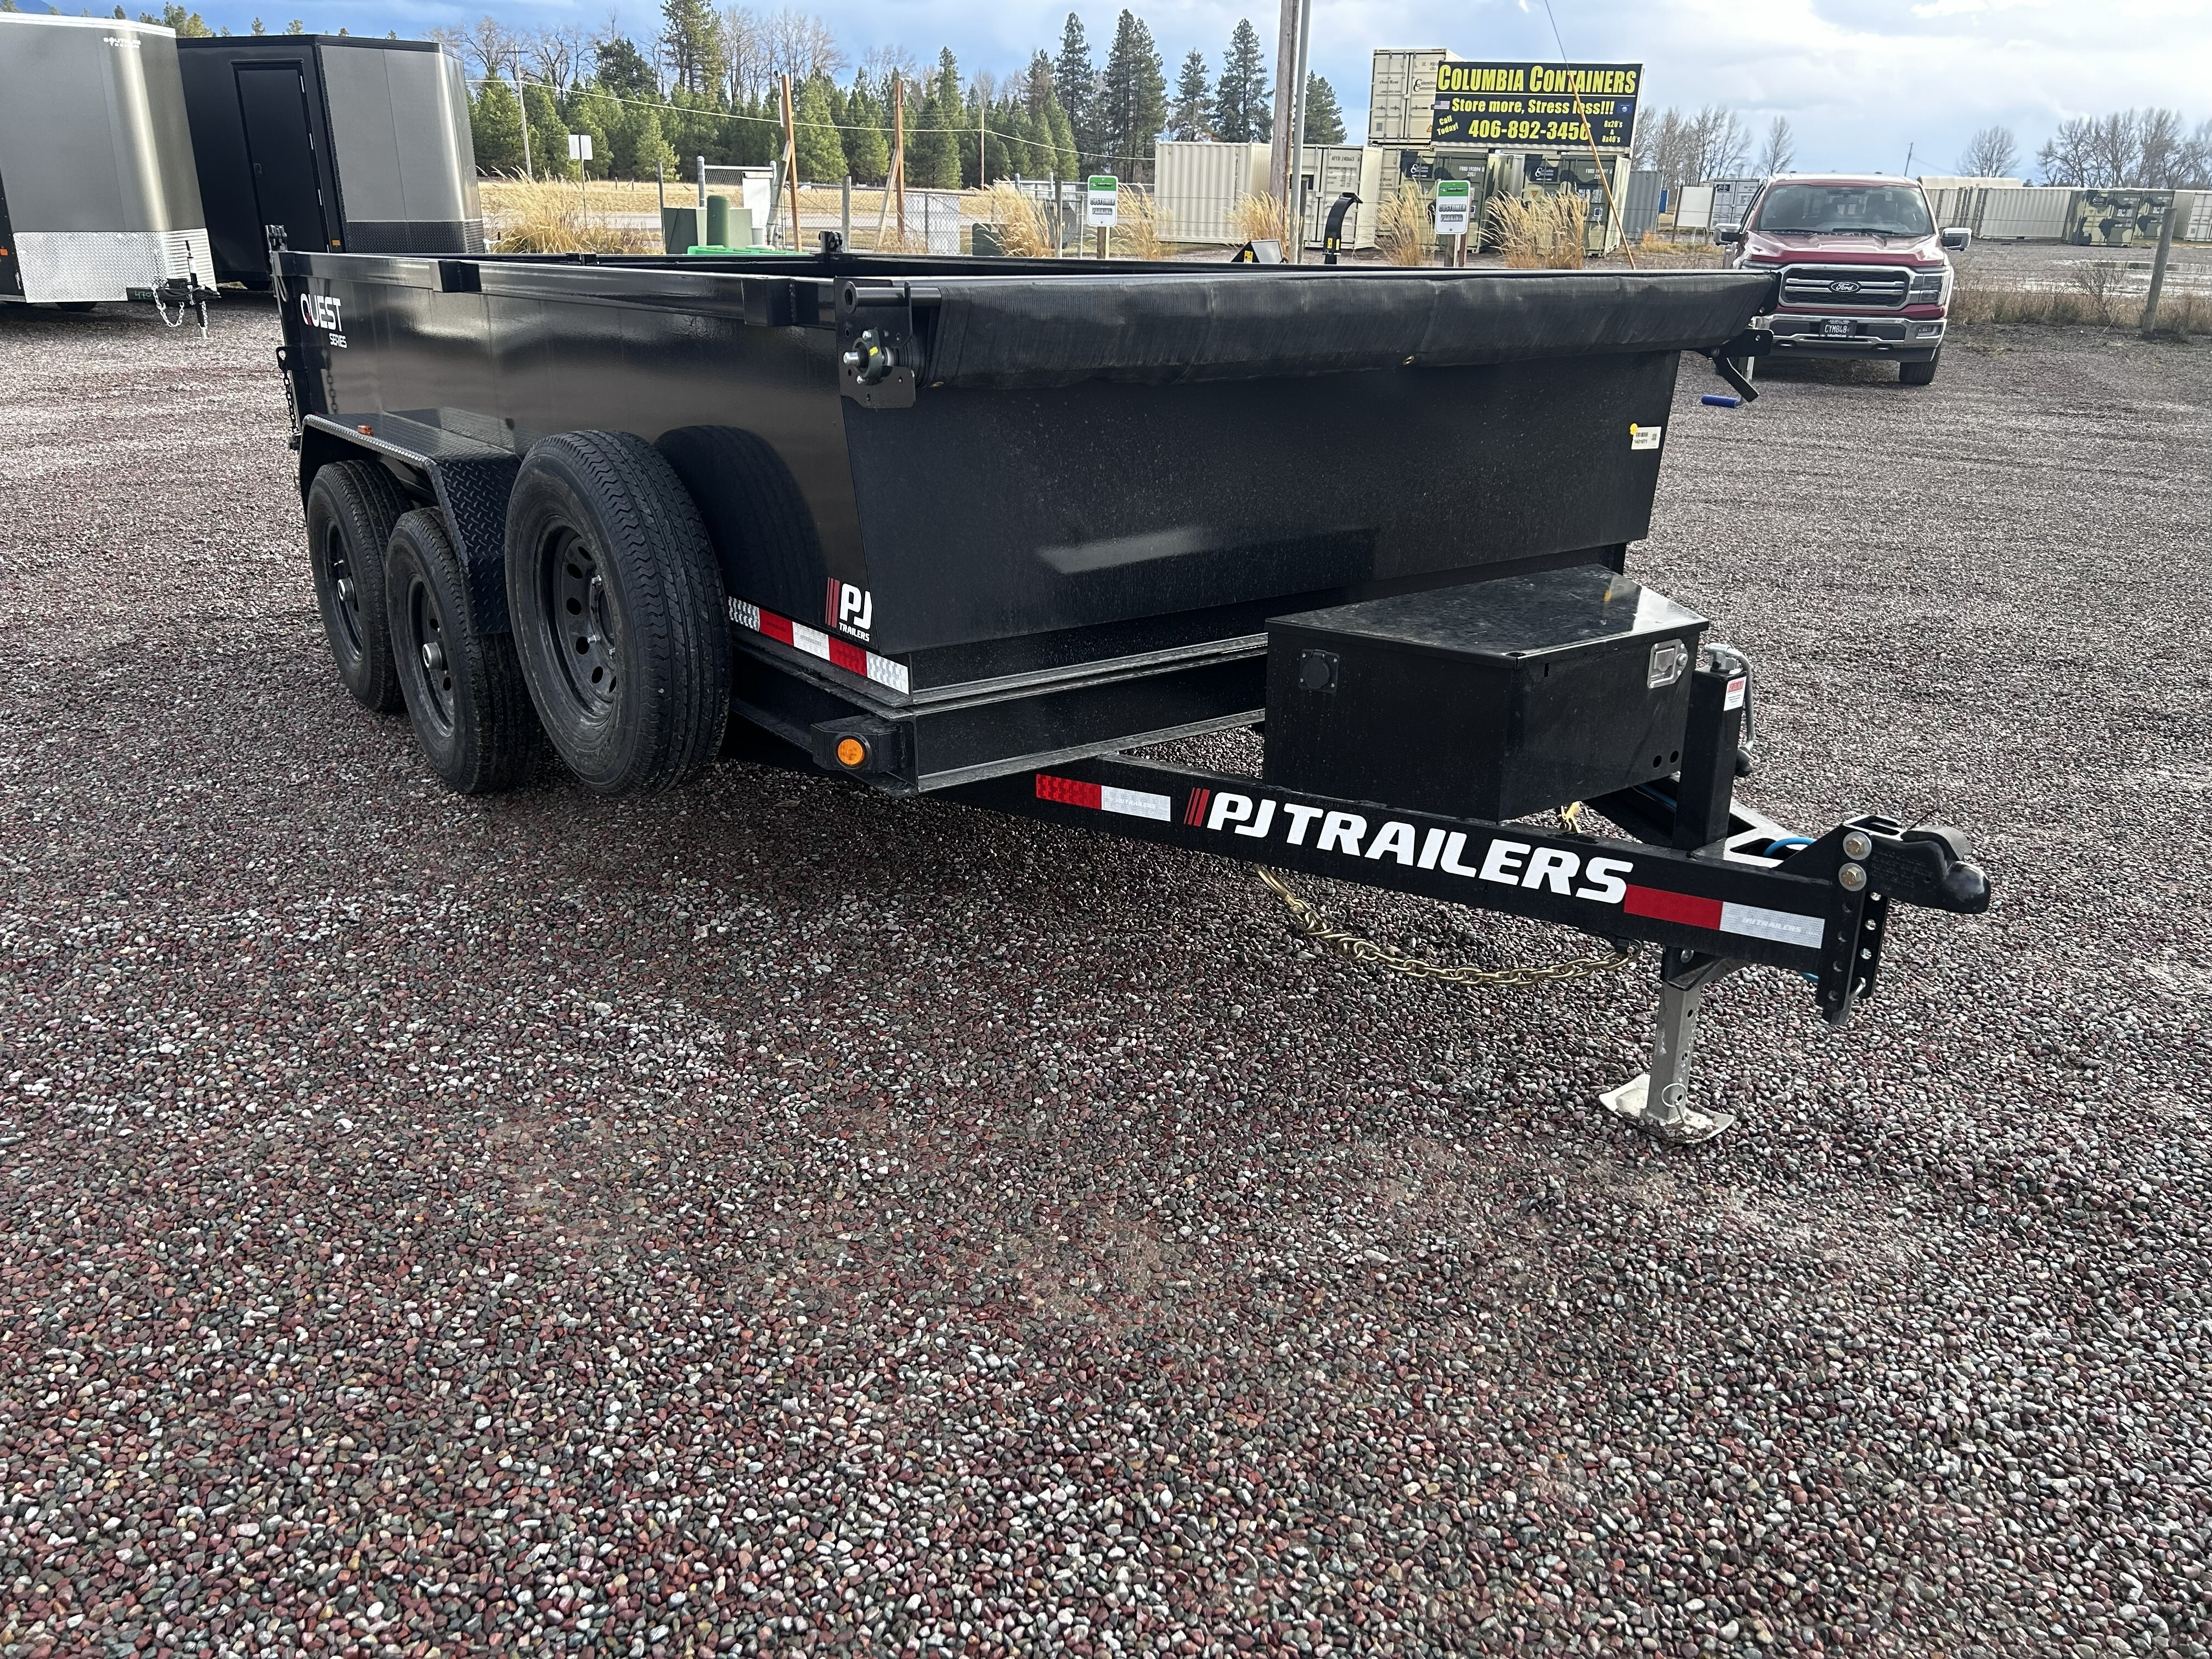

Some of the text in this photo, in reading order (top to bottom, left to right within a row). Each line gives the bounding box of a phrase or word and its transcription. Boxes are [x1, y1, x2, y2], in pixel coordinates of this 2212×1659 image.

[1438, 64, 1636, 93] COLUMBIA CONTAINERS
[1452, 98, 1615, 115] Store more, Stress less!!!
[1436, 122, 1459, 136] Today!
[1439, 115, 1452, 125] Call
[1468, 120, 1591, 140] 406-892-3456
[300, 293, 342, 332] QUEST
[1825, 325, 1847, 333] CYM848
[329, 332, 347, 348] SERIES
[839, 583, 872, 630] PJ
[839, 622, 870, 642] TRAILERS
[1207, 792, 1634, 904] PJ TRAILERS
